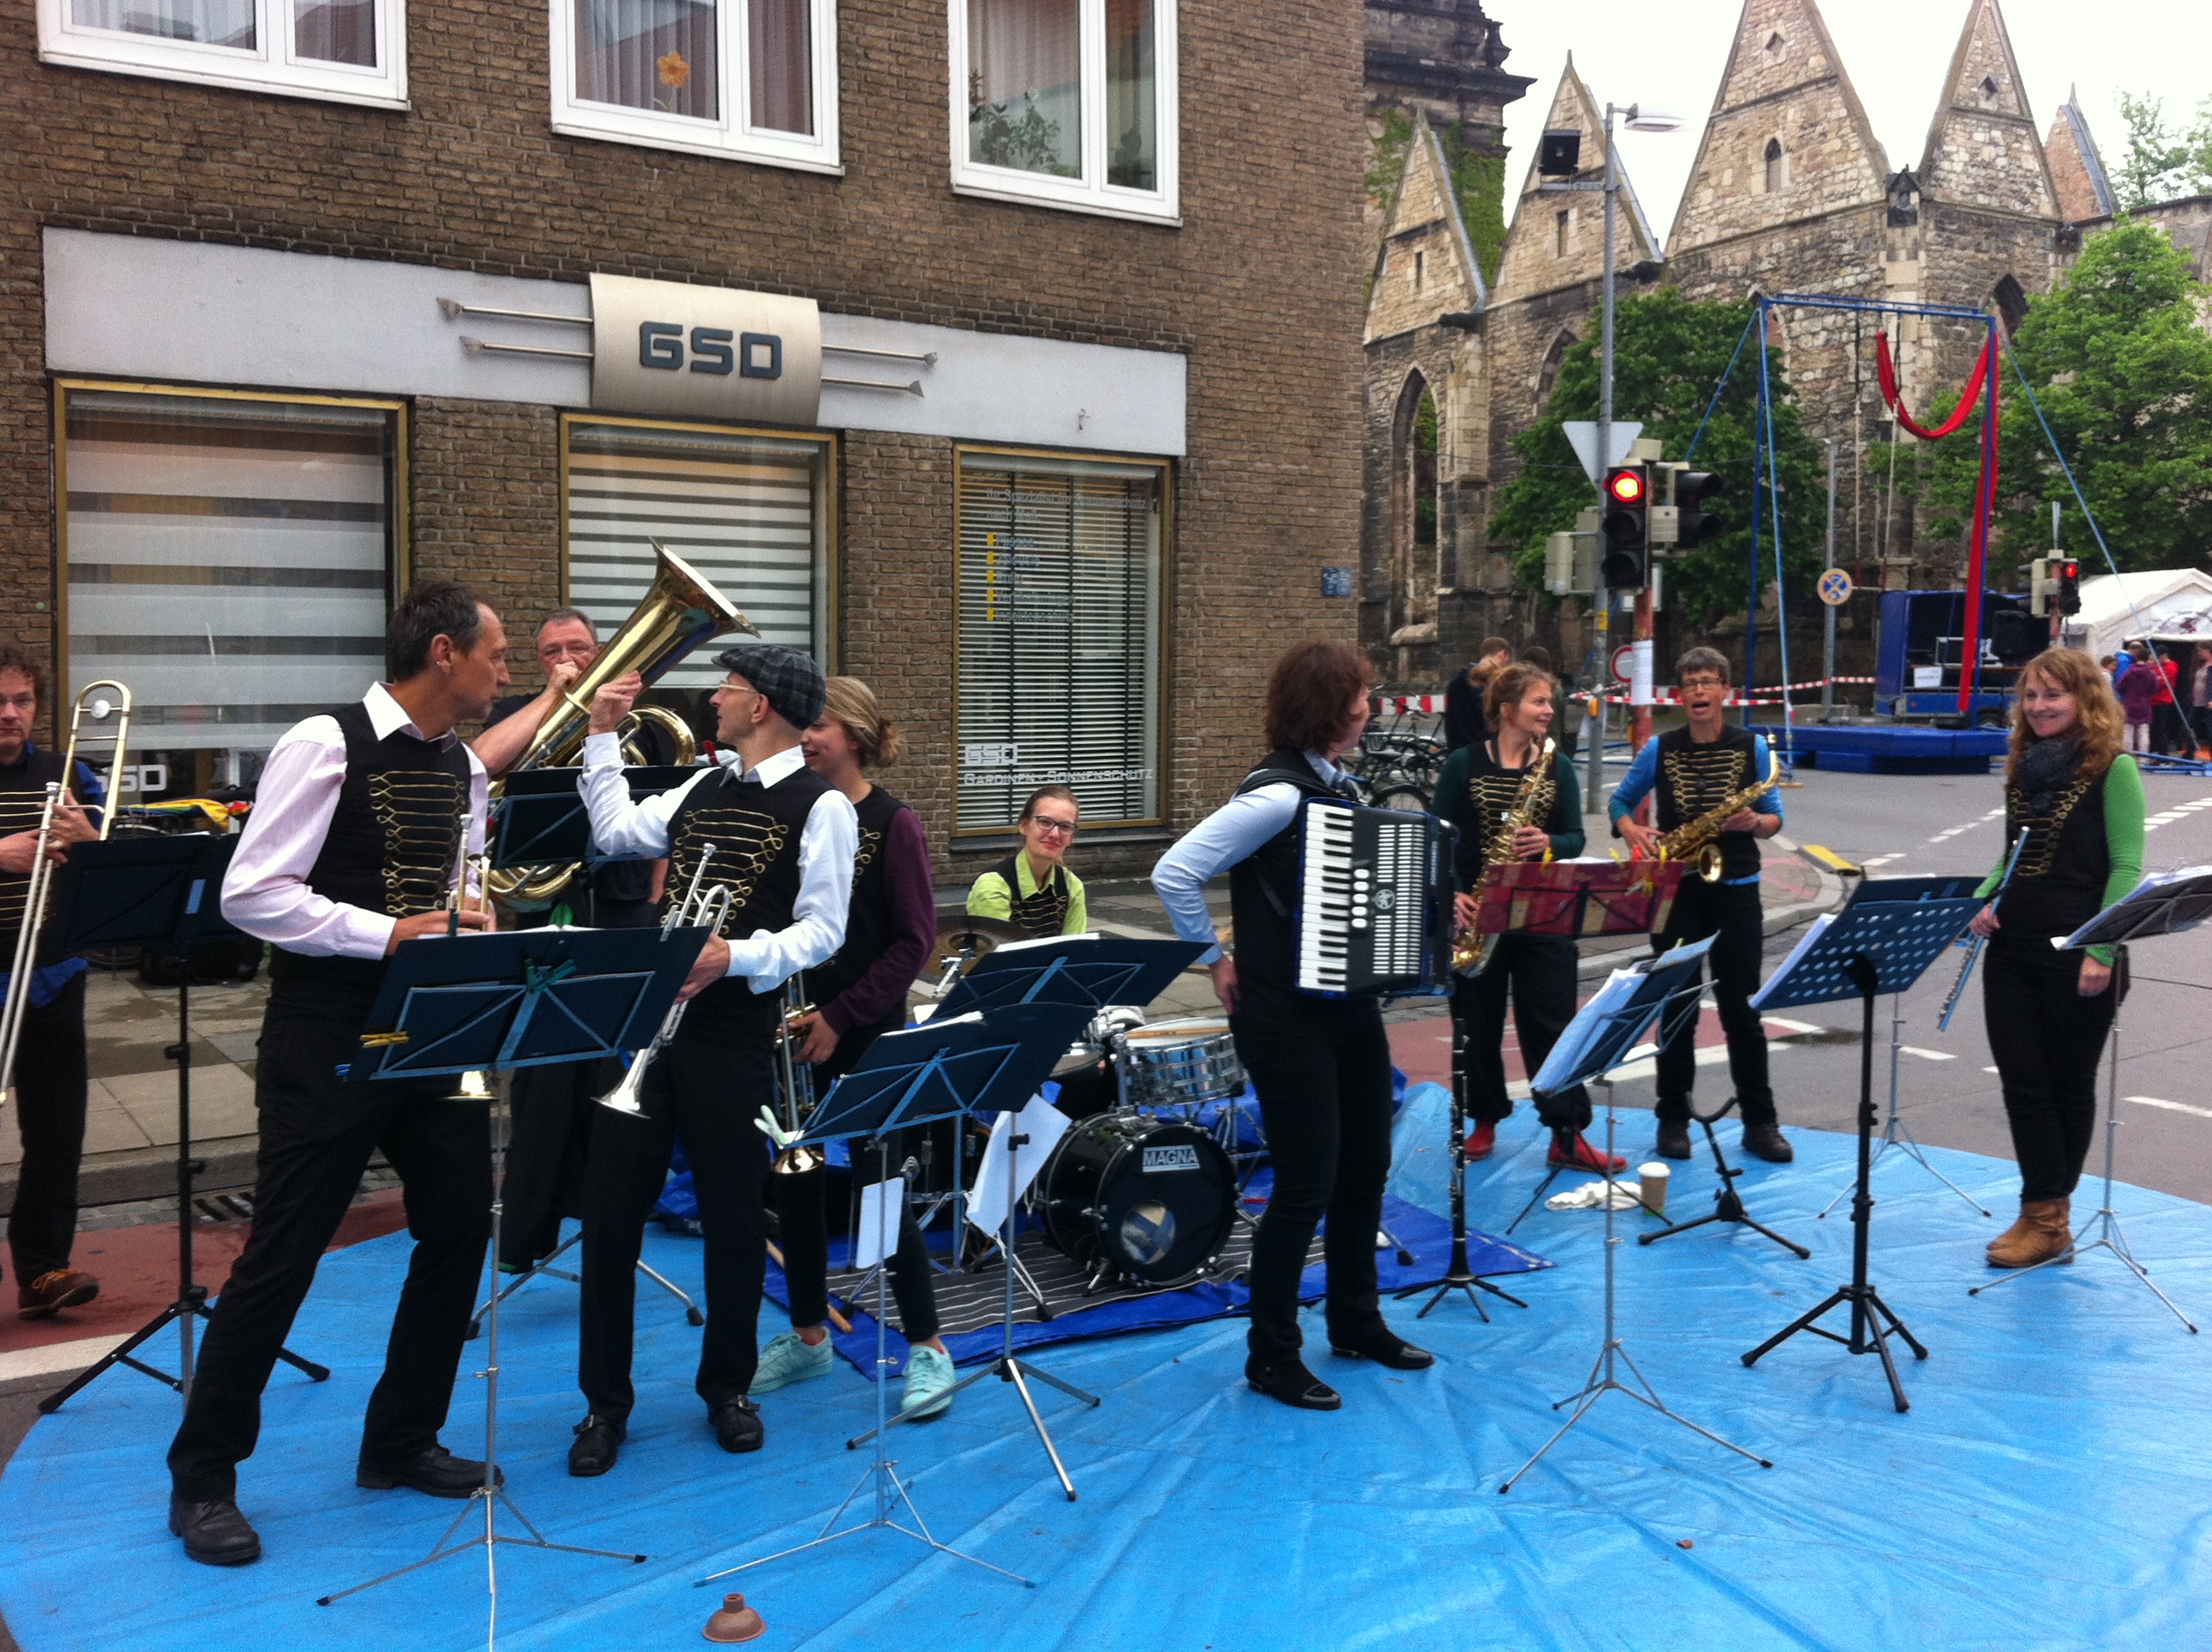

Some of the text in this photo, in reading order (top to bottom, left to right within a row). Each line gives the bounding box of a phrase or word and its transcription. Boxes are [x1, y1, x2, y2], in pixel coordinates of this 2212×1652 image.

[639, 321, 783, 380] GSD
[996, 609, 1074, 623] Insektenschutz
[965, 744, 1018, 765] GSD
[1143, 1149, 1199, 1166] MAGNA
